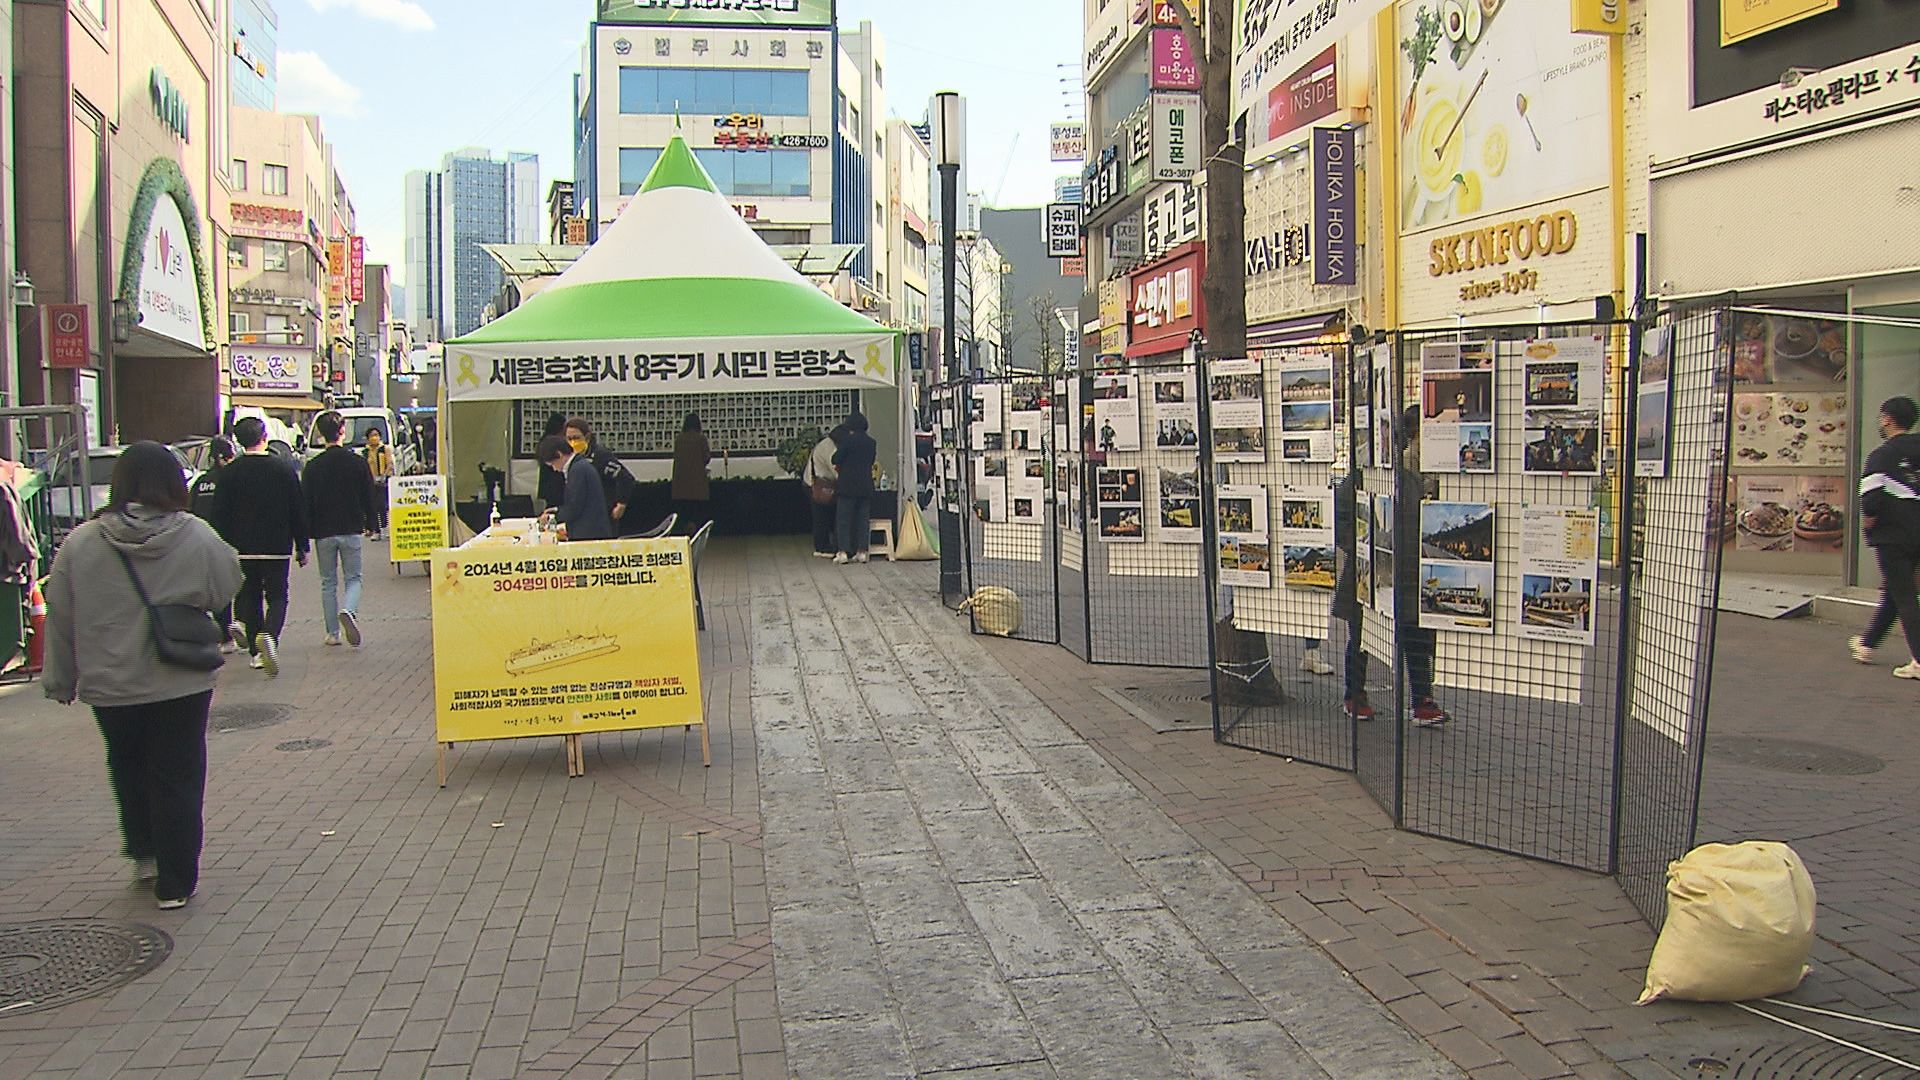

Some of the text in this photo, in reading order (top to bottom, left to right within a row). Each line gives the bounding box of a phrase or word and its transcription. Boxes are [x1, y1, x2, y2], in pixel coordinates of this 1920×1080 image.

[1290, 77, 1335, 113] INSIDE
[1764, 70, 1882, 122] 파스타&필라프
[728, 113, 763, 129] 우리
[716, 132, 769, 150] 부동산
[1053, 127, 1081, 139] 동성로
[1169, 109, 1184, 164] 에코폰
[1052, 142, 1081, 154] 부동산
[1327, 130, 1344, 282] HOLIKA HOLIKA
[1052, 210, 1075, 222] 슈퍼
[1052, 224, 1076, 236] 전자
[1052, 239, 1076, 250] 담배
[1428, 208, 1579, 278] SKINFOOD
[1459, 268, 1538, 301] since 1957
[56, 348, 84, 358] 안내소
[489, 349, 856, 386] 세월호참사 8주기 시민 분향소
[418, 494, 440, 505] 약속
[464, 552, 683, 577] 2014년 4월 16일 세월호참사로 희생된
[493, 571, 657, 592] 304명의 이웃을 기억합니다.
[454, 690, 489, 700] 피해자가
[520, 687, 528, 696] 수
[531, 686, 548, 695] 있는
[570, 684, 587, 692] 없는
[590, 680, 632, 691] 진상규명과
[635, 678, 660, 687] 책임자
[567, 694, 592, 704] 안전한
[595, 691, 620, 701] 사회를
[623, 688, 657, 699] 이루어야
[660, 686, 687, 697] 합니다.
